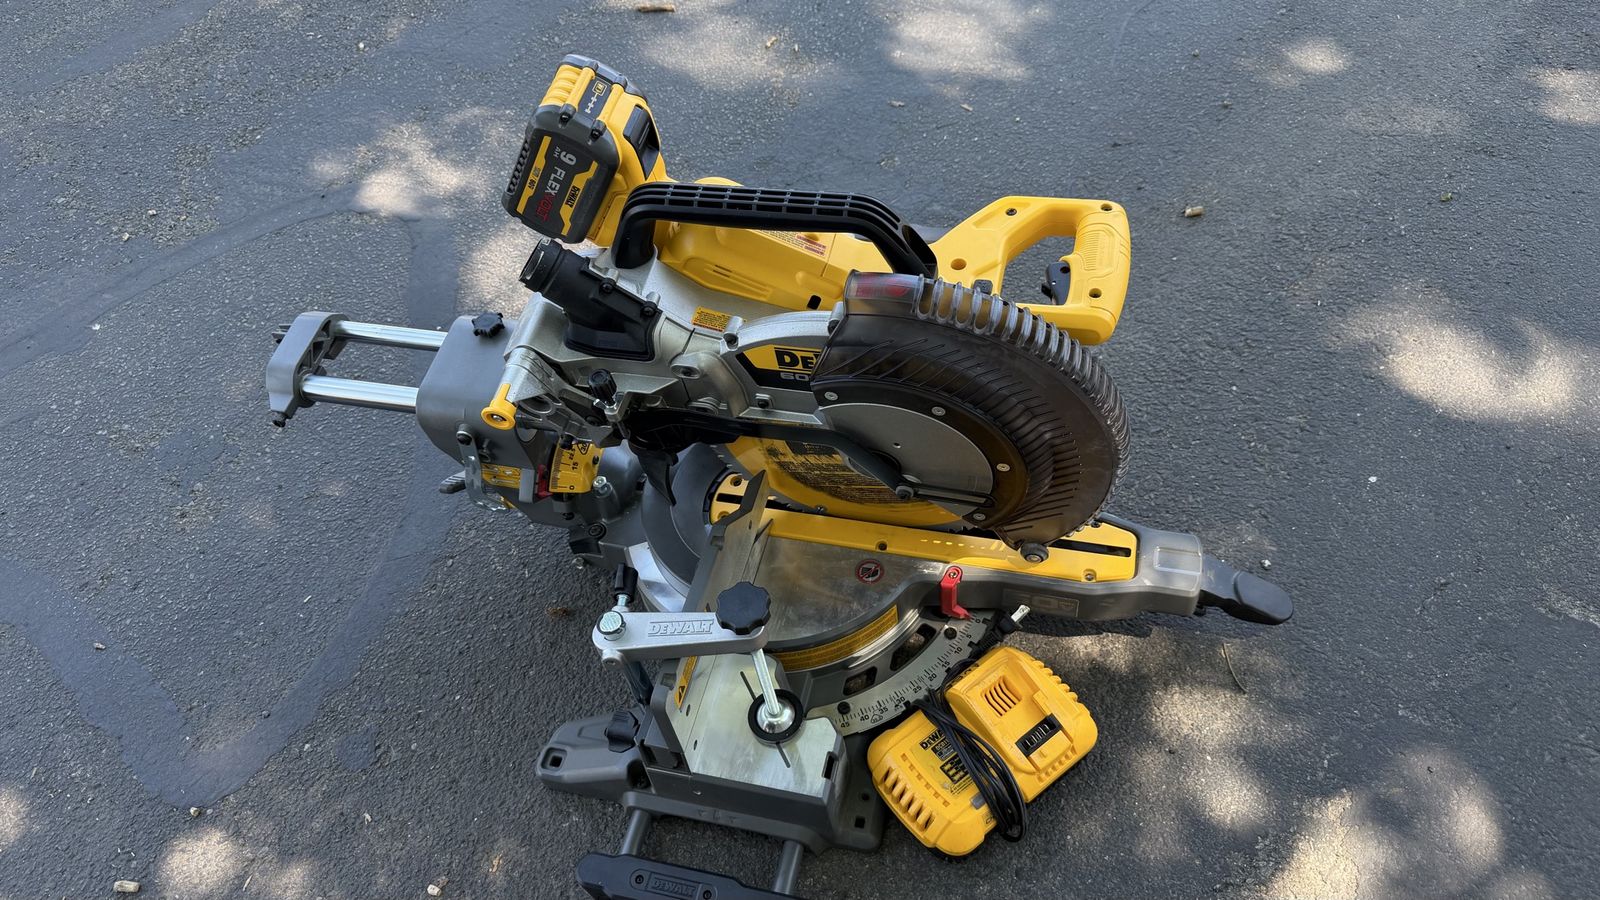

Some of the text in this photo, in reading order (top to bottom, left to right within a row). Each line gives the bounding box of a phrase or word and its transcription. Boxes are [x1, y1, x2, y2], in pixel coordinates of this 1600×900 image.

[560, 152, 576, 165] 9
[571, 461, 579, 470] 15
[648, 619, 715, 636] DEWALT
[954, 647, 963, 655] 10
[941, 661, 951, 669] 15
[927, 673, 938, 682] 20
[912, 685, 922, 694] 25
[878, 706, 889, 715] 35
[860, 714, 870, 722] 40
[840, 721, 850, 729] 45
